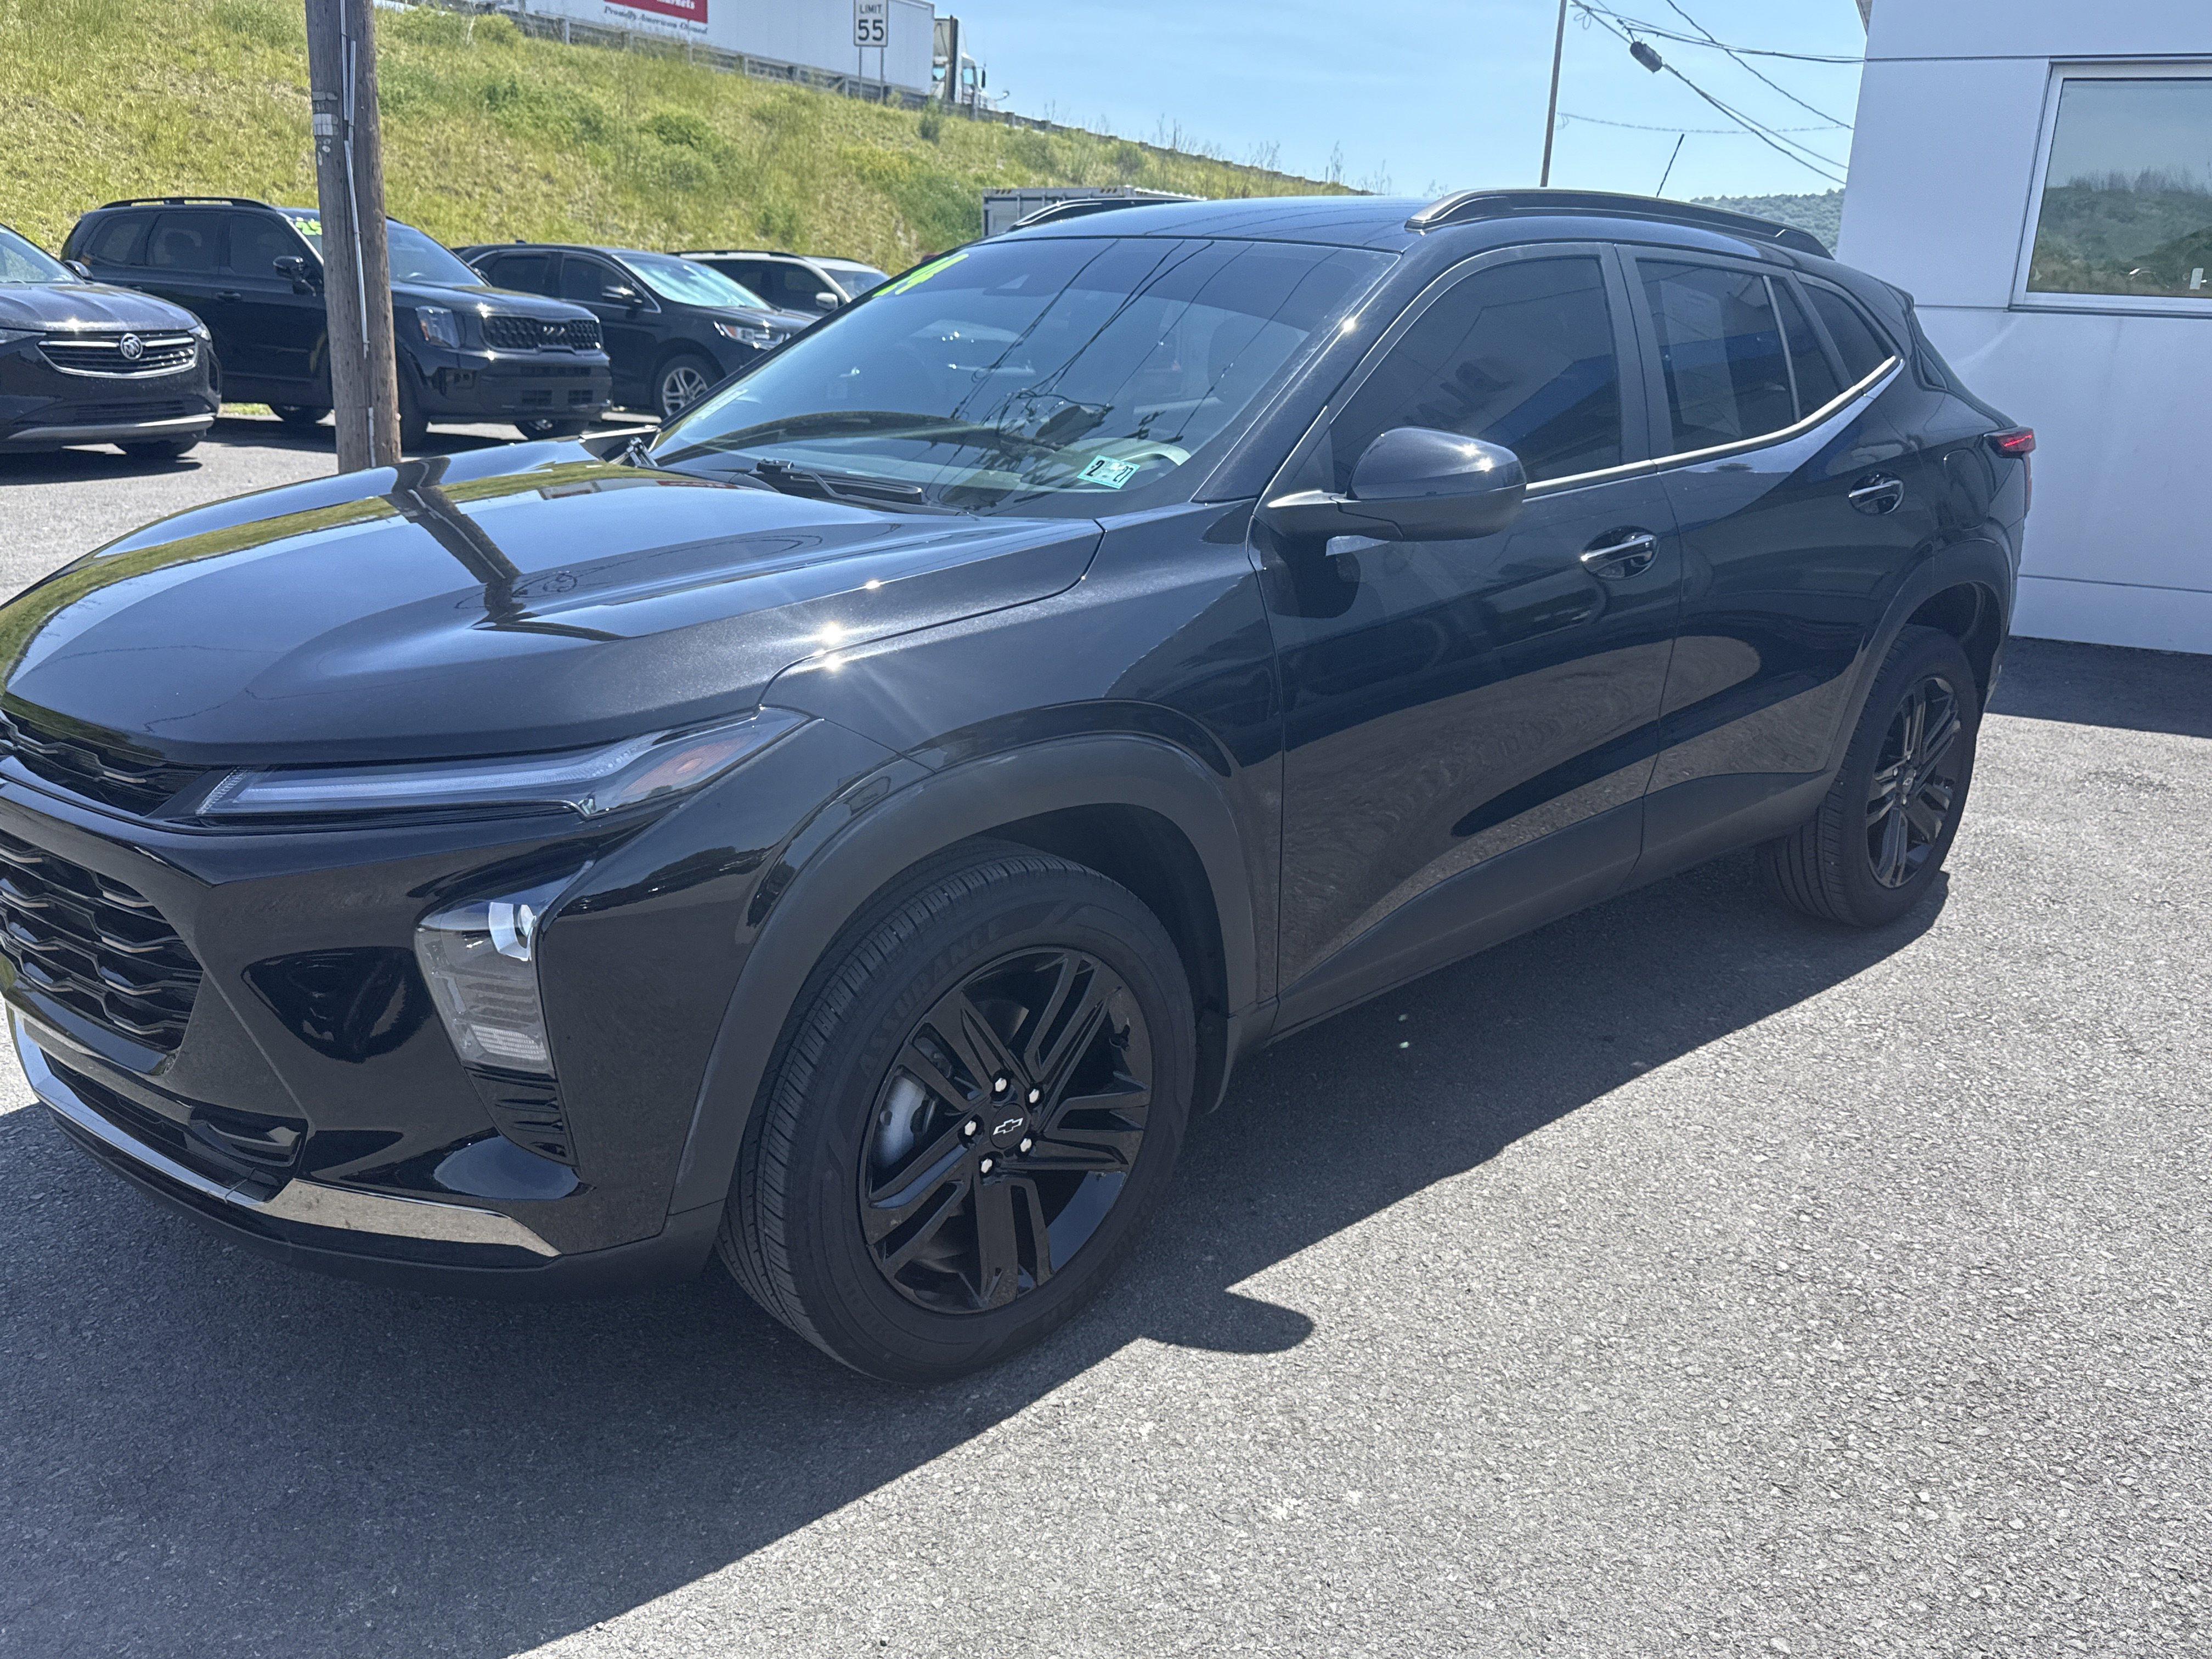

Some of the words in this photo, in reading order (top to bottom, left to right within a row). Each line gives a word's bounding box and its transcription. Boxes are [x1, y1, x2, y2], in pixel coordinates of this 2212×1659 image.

[859, 4, 882, 14] LIMIT
[857, 19, 884, 41] 55
[1113, 465, 1134, 483] 27
[858, 919, 1005, 1079] ASSURANCE
